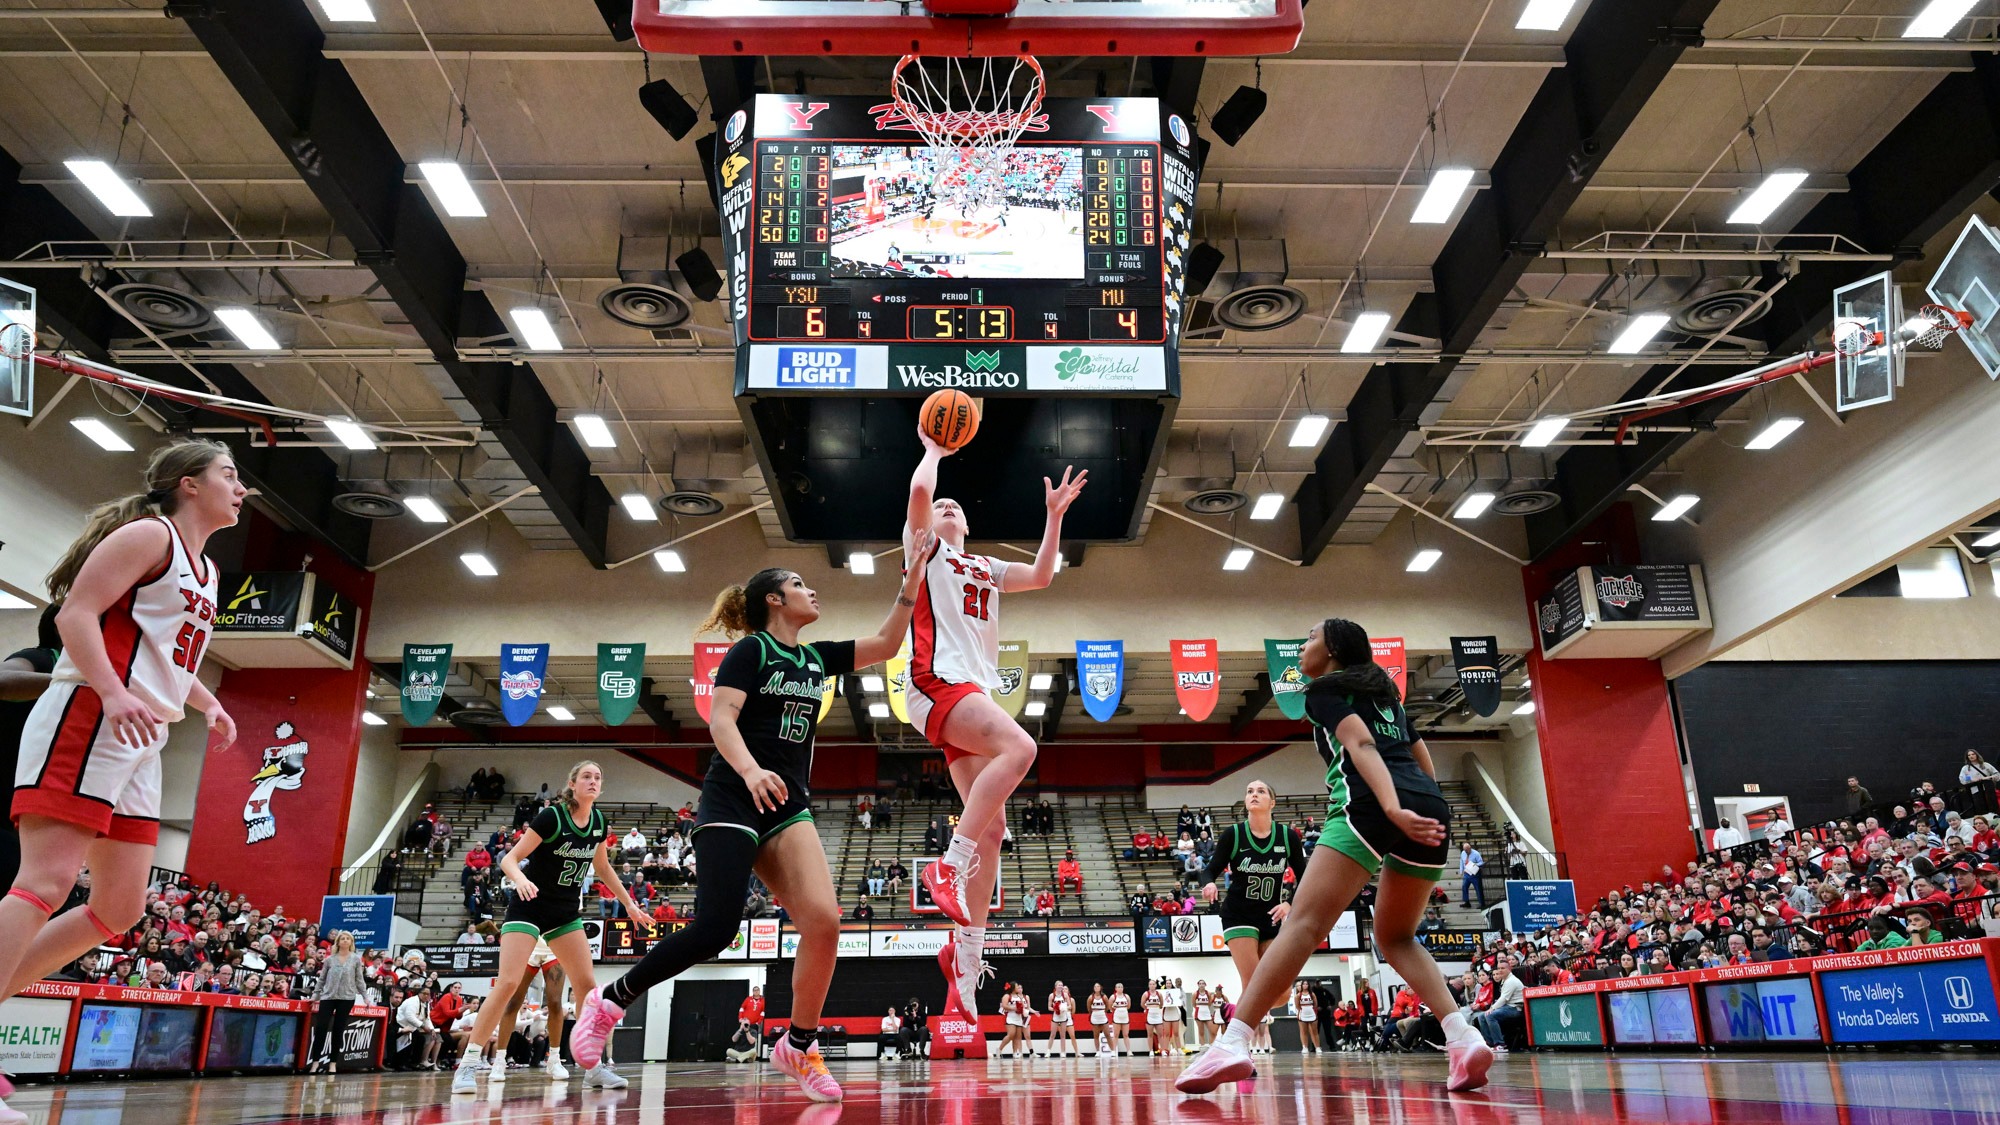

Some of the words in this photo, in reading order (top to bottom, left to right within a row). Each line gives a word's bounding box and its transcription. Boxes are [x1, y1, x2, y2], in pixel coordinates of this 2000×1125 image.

[784, 103, 829, 130] Y
[811, 146, 826, 154] PTS
[774, 156, 784, 171] 2
[791, 156, 799, 171] 0
[818, 157, 828, 171] 3
[1098, 160, 1107, 173] 0
[1120, 161, 1124, 173] 1
[1142, 160, 1151, 173] 0
[1164, 153, 1194, 180] BUFFALO
[774, 175, 783, 188] 4
[791, 174, 799, 189] 0
[818, 174, 827, 189] 0
[1098, 177, 1107, 191] 2
[1116, 177, 1125, 191] 0
[1142, 177, 1151, 191] 0
[1164, 163, 1193, 194] WILD
[723, 178, 752, 202] BUFFALO
[1164, 178, 1193, 206] WINGS
[723, 187, 752, 217] WILD
[768, 192, 783, 206] 14
[795, 193, 799, 206] 1
[818, 192, 827, 206] 2
[1093, 195, 1108, 209] 15
[1116, 195, 1125, 209] 0
[1143, 195, 1152, 209] 0
[761, 210, 782, 224] 21
[790, 210, 799, 224] 0
[823, 210, 827, 224] 1
[1089, 212, 1109, 226] 20
[1116, 212, 1125, 226] 0
[1143, 212, 1153, 226] 0
[761, 228, 782, 242] 50
[790, 227, 799, 242] 0
[817, 228, 827, 242] 0
[1089, 230, 1109, 244] 24
[1116, 230, 1126, 244] 0
[1144, 230, 1153, 244] 0
[728, 206, 747, 320] WINGS
[791, 273, 816, 281] BONUS
[1099, 275, 1124, 283] BONUS
[785, 287, 818, 303] YSU
[885, 295, 906, 303] POSS
[1102, 289, 1124, 305] MU
[806, 308, 824, 337] 6
[859, 322, 870, 337] 4
[935, 310, 1005, 337] 5:13
[1118, 311, 1136, 338] 4
[1046, 323, 1056, 338] 4
[792, 351, 842, 367] BUD
[1064, 355, 1140, 380] Chrystal
[781, 368, 851, 383] LIGHT
[896, 365, 1019, 387] WesBanco
[1104, 374, 1134, 382] Catering
[1596, 581, 1644, 599] BUCKEYE
[963, 583, 991, 621] 21
[313, 619, 347, 650] AxioFitness
[172, 620, 206, 675] 50
[502, 679, 540, 689] TITANS
[600, 671, 636, 699] GB
[1177, 671, 1214, 687] RMU
[695, 684, 707, 696] IU
[779, 701, 813, 743] 15
[1374, 719, 1401, 740] YEAST
[270, 749, 282, 757] Y
[249, 799, 268, 814] Y
[558, 860, 589, 887] 24
[1246, 876, 1275, 901] 20
[1059, 931, 1131, 945] eastwood
[1146, 927, 1167, 935] alta
[621, 931, 632, 947] 6
[918, 942, 942, 950] OHIO
[1430, 934, 1482, 944] TRADER
[1897, 943, 1982, 962] AXIOFITNESS.COM
[1812, 954, 1883, 969] AXIOFITNESS.COM
[1718, 968, 1747, 978] STRETCH
[1748, 964, 1773, 976] THERAPY
[1615, 979, 1640, 988] PERSONAL
[1641, 977, 1664, 986] TRAINING
[121, 990, 150, 1000] STRETCH
[152, 991, 182, 1002] THERAPY
[1840, 985, 1862, 1001] The
[1862, 982, 1904, 1004] Valley's
[239, 998, 266, 1008] PERSONAL
[267, 999, 290, 1010] TRAINING
[1838, 1010, 1874, 1027] Honda
[1877, 1008, 1919, 1025] Dealers
[1941, 1012, 1989, 1024] HONDA
[0, 1026, 62, 1046] HEALTH
[339, 1027, 374, 1052] STOWN
[1545, 1031, 1568, 1041] MEDICAL
[1568, 1031, 1591, 1041] MUTUAL
[20, 1052, 31, 1061] State
[33, 1052, 56, 1060] University
[344, 1052, 361, 1060] CLOTHING
